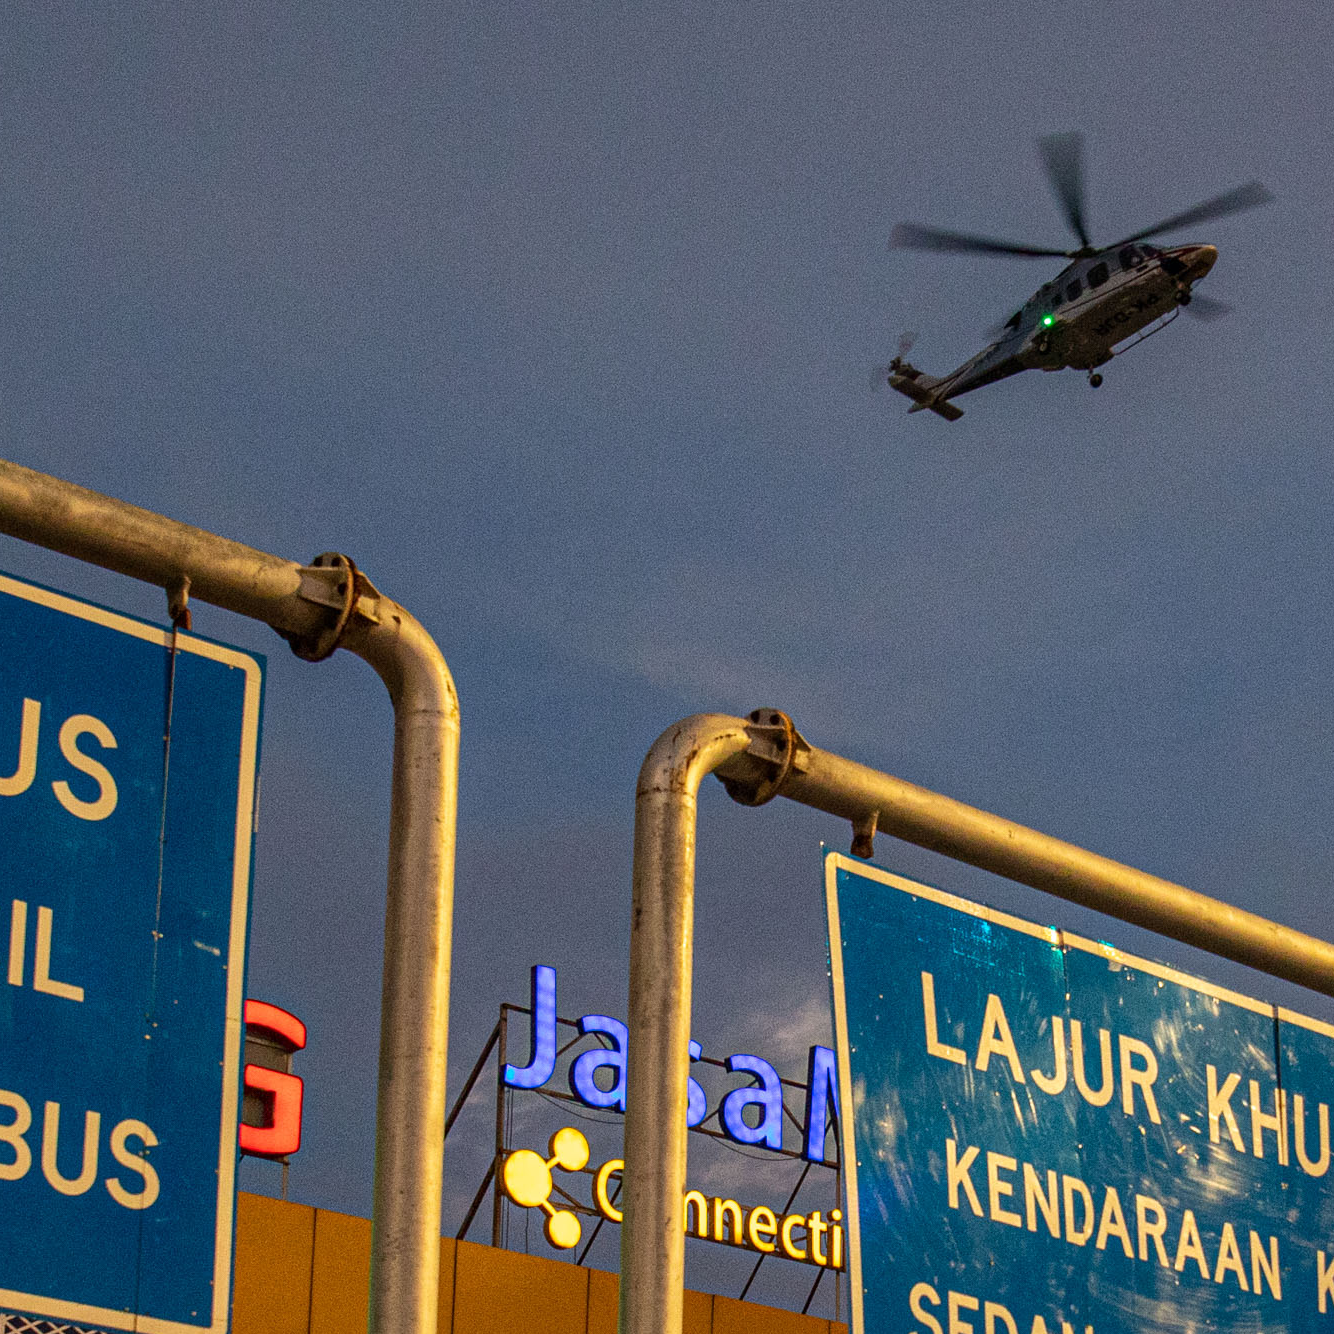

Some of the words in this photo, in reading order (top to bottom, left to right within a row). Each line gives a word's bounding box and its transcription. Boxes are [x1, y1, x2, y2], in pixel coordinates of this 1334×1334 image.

[921, 970, 1162, 1125] LAJUR
[593, 1159, 843, 1268] Cnnecti
[945, 1138, 1282, 1301] KENDARAAN
